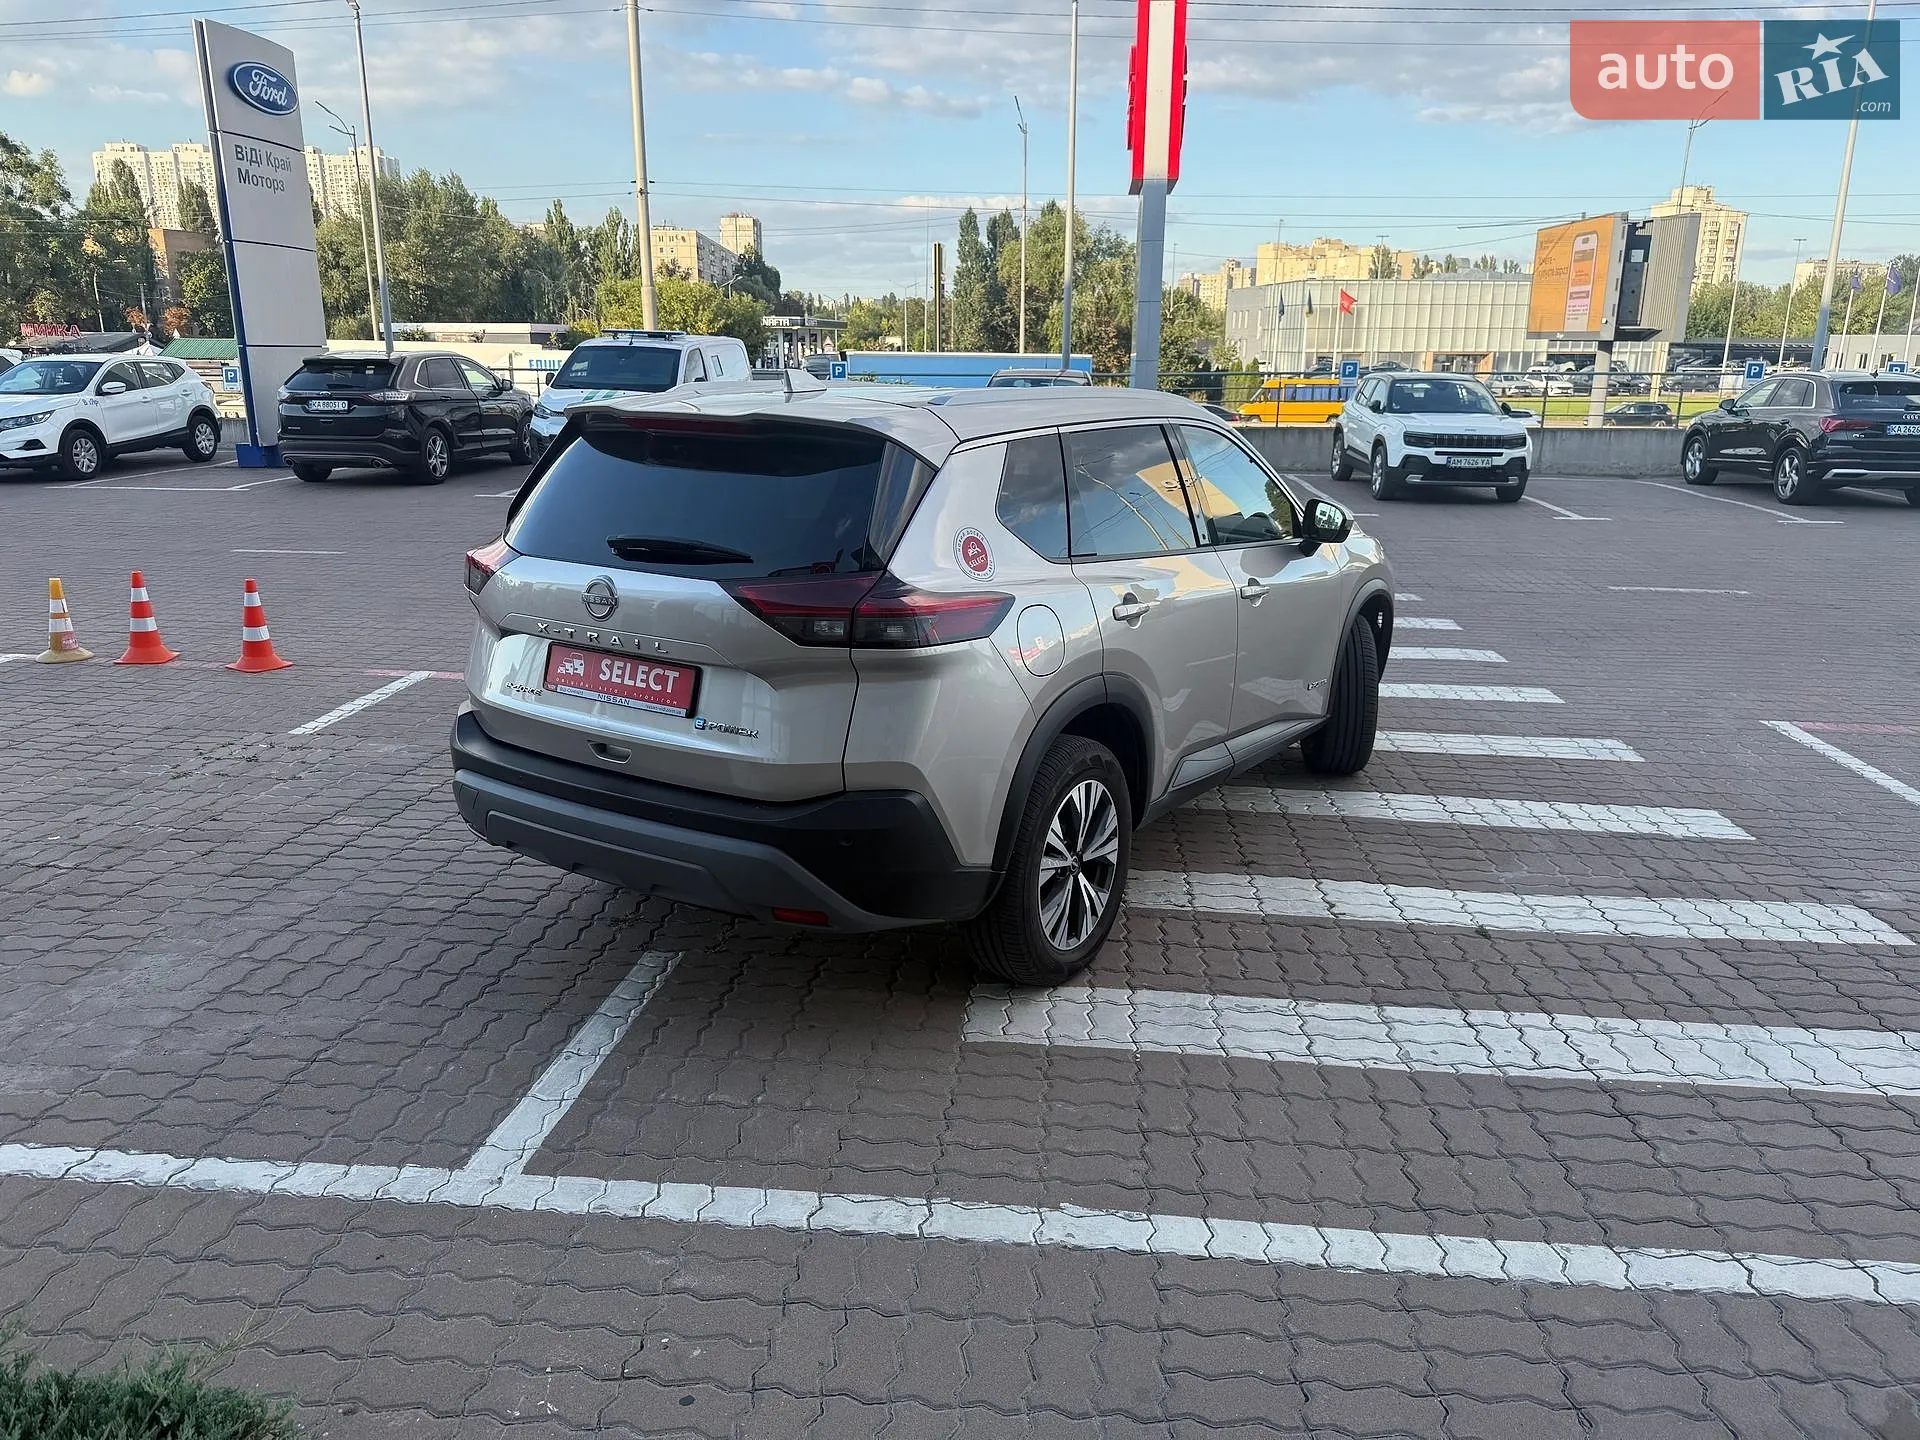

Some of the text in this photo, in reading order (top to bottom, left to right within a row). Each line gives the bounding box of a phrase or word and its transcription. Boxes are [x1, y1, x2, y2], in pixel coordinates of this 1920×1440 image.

[249, 69, 288, 106] Ford
[234, 144, 292, 173] ВіДі Край
[237, 167, 285, 194] Моторз
[228, 371, 235, 381] P
[835, 366, 843, 376] P
[1345, 365, 1354, 375] P
[1750, 366, 1760, 376] P
[969, 554, 986, 568] SELECT
[582, 592, 616, 606] NISSAN
[536, 622, 668, 654] X-TRAIL
[599, 658, 680, 693] SELECT
[597, 693, 630, 706] NISSAN
